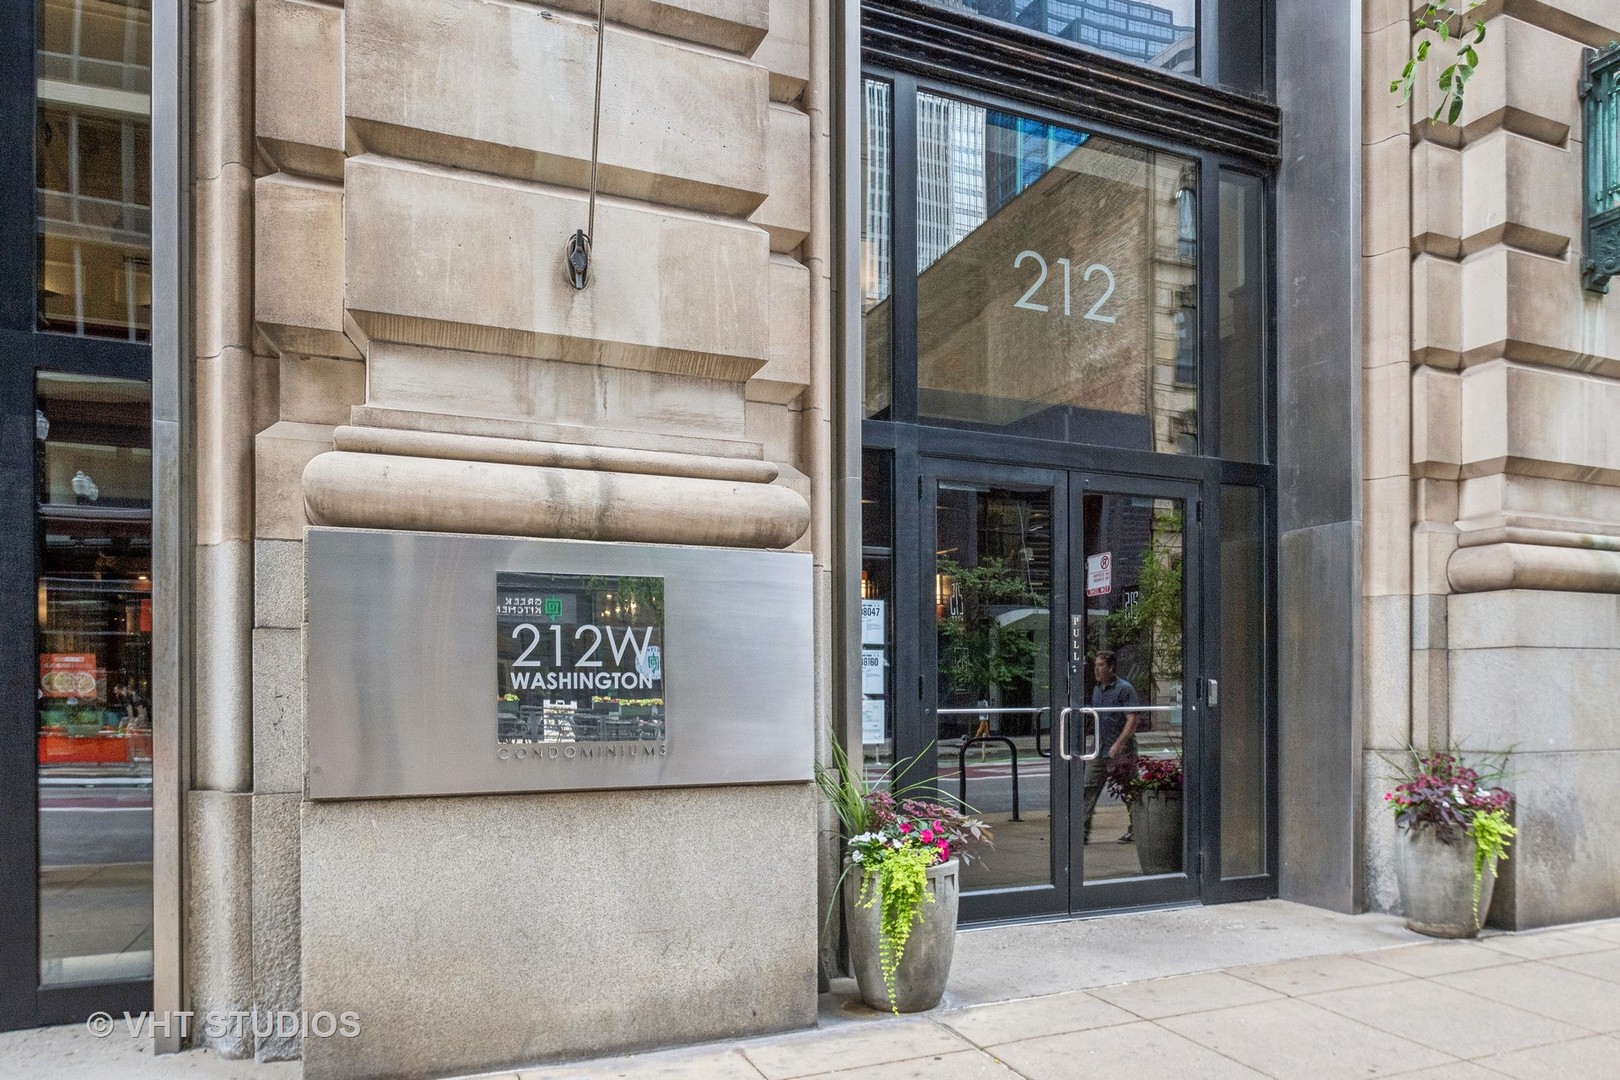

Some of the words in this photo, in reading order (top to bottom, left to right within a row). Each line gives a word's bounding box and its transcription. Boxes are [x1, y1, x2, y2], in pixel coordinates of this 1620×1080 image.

[1013, 249, 1116, 324] 212
[860, 607, 880, 617] 8047
[510, 672, 653, 690] WASHINGTON
[498, 744, 666, 760] CONDOMINIUMS
